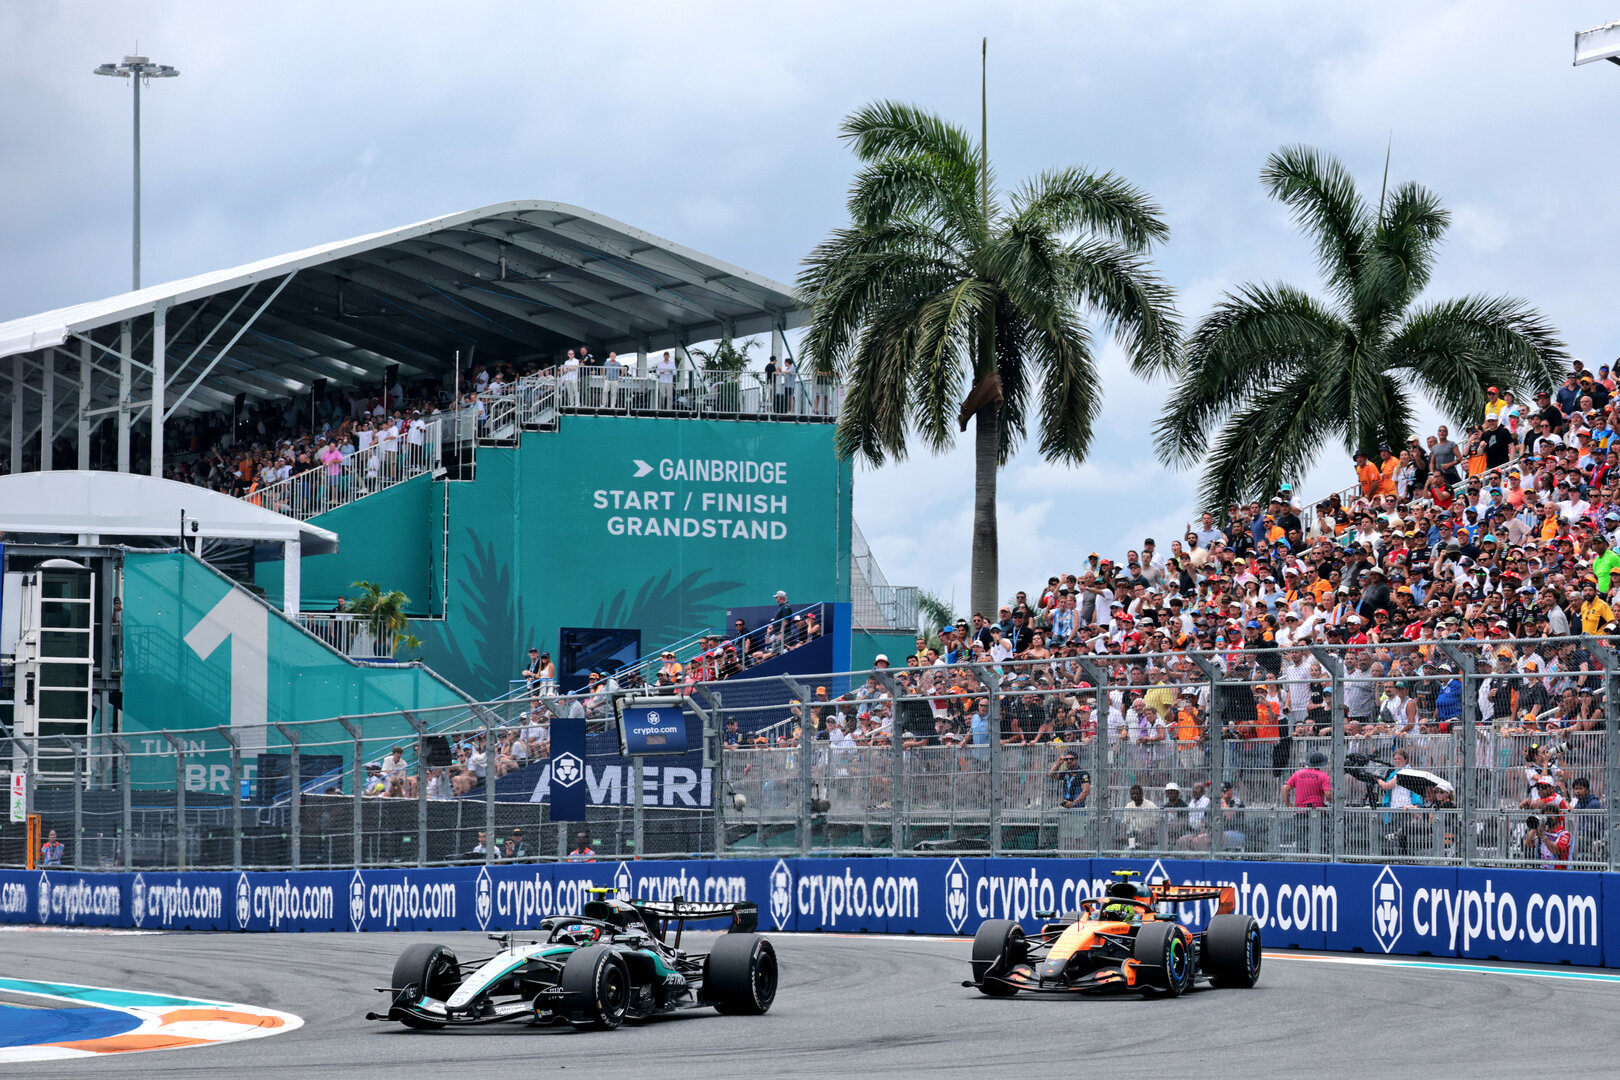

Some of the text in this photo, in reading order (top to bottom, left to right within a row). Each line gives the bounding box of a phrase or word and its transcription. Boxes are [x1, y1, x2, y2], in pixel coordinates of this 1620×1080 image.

[659, 458, 788, 484] GAINBRIDGE
[593, 489, 788, 514] START / FINISH
[606, 515, 788, 540] GRANDSTAND
[633, 726, 678, 735] crypto.com
[52, 878, 121, 923] crypto.com
[148, 878, 222, 925] crypto.com
[254, 879, 333, 927] crypto.com
[369, 876, 456, 927] crypto.com
[497, 872, 594, 925] crypto.com
[637, 867, 746, 924] cryptocom
[798, 867, 919, 926] crypto.com
[1412, 879, 1598, 951] crypto.com
